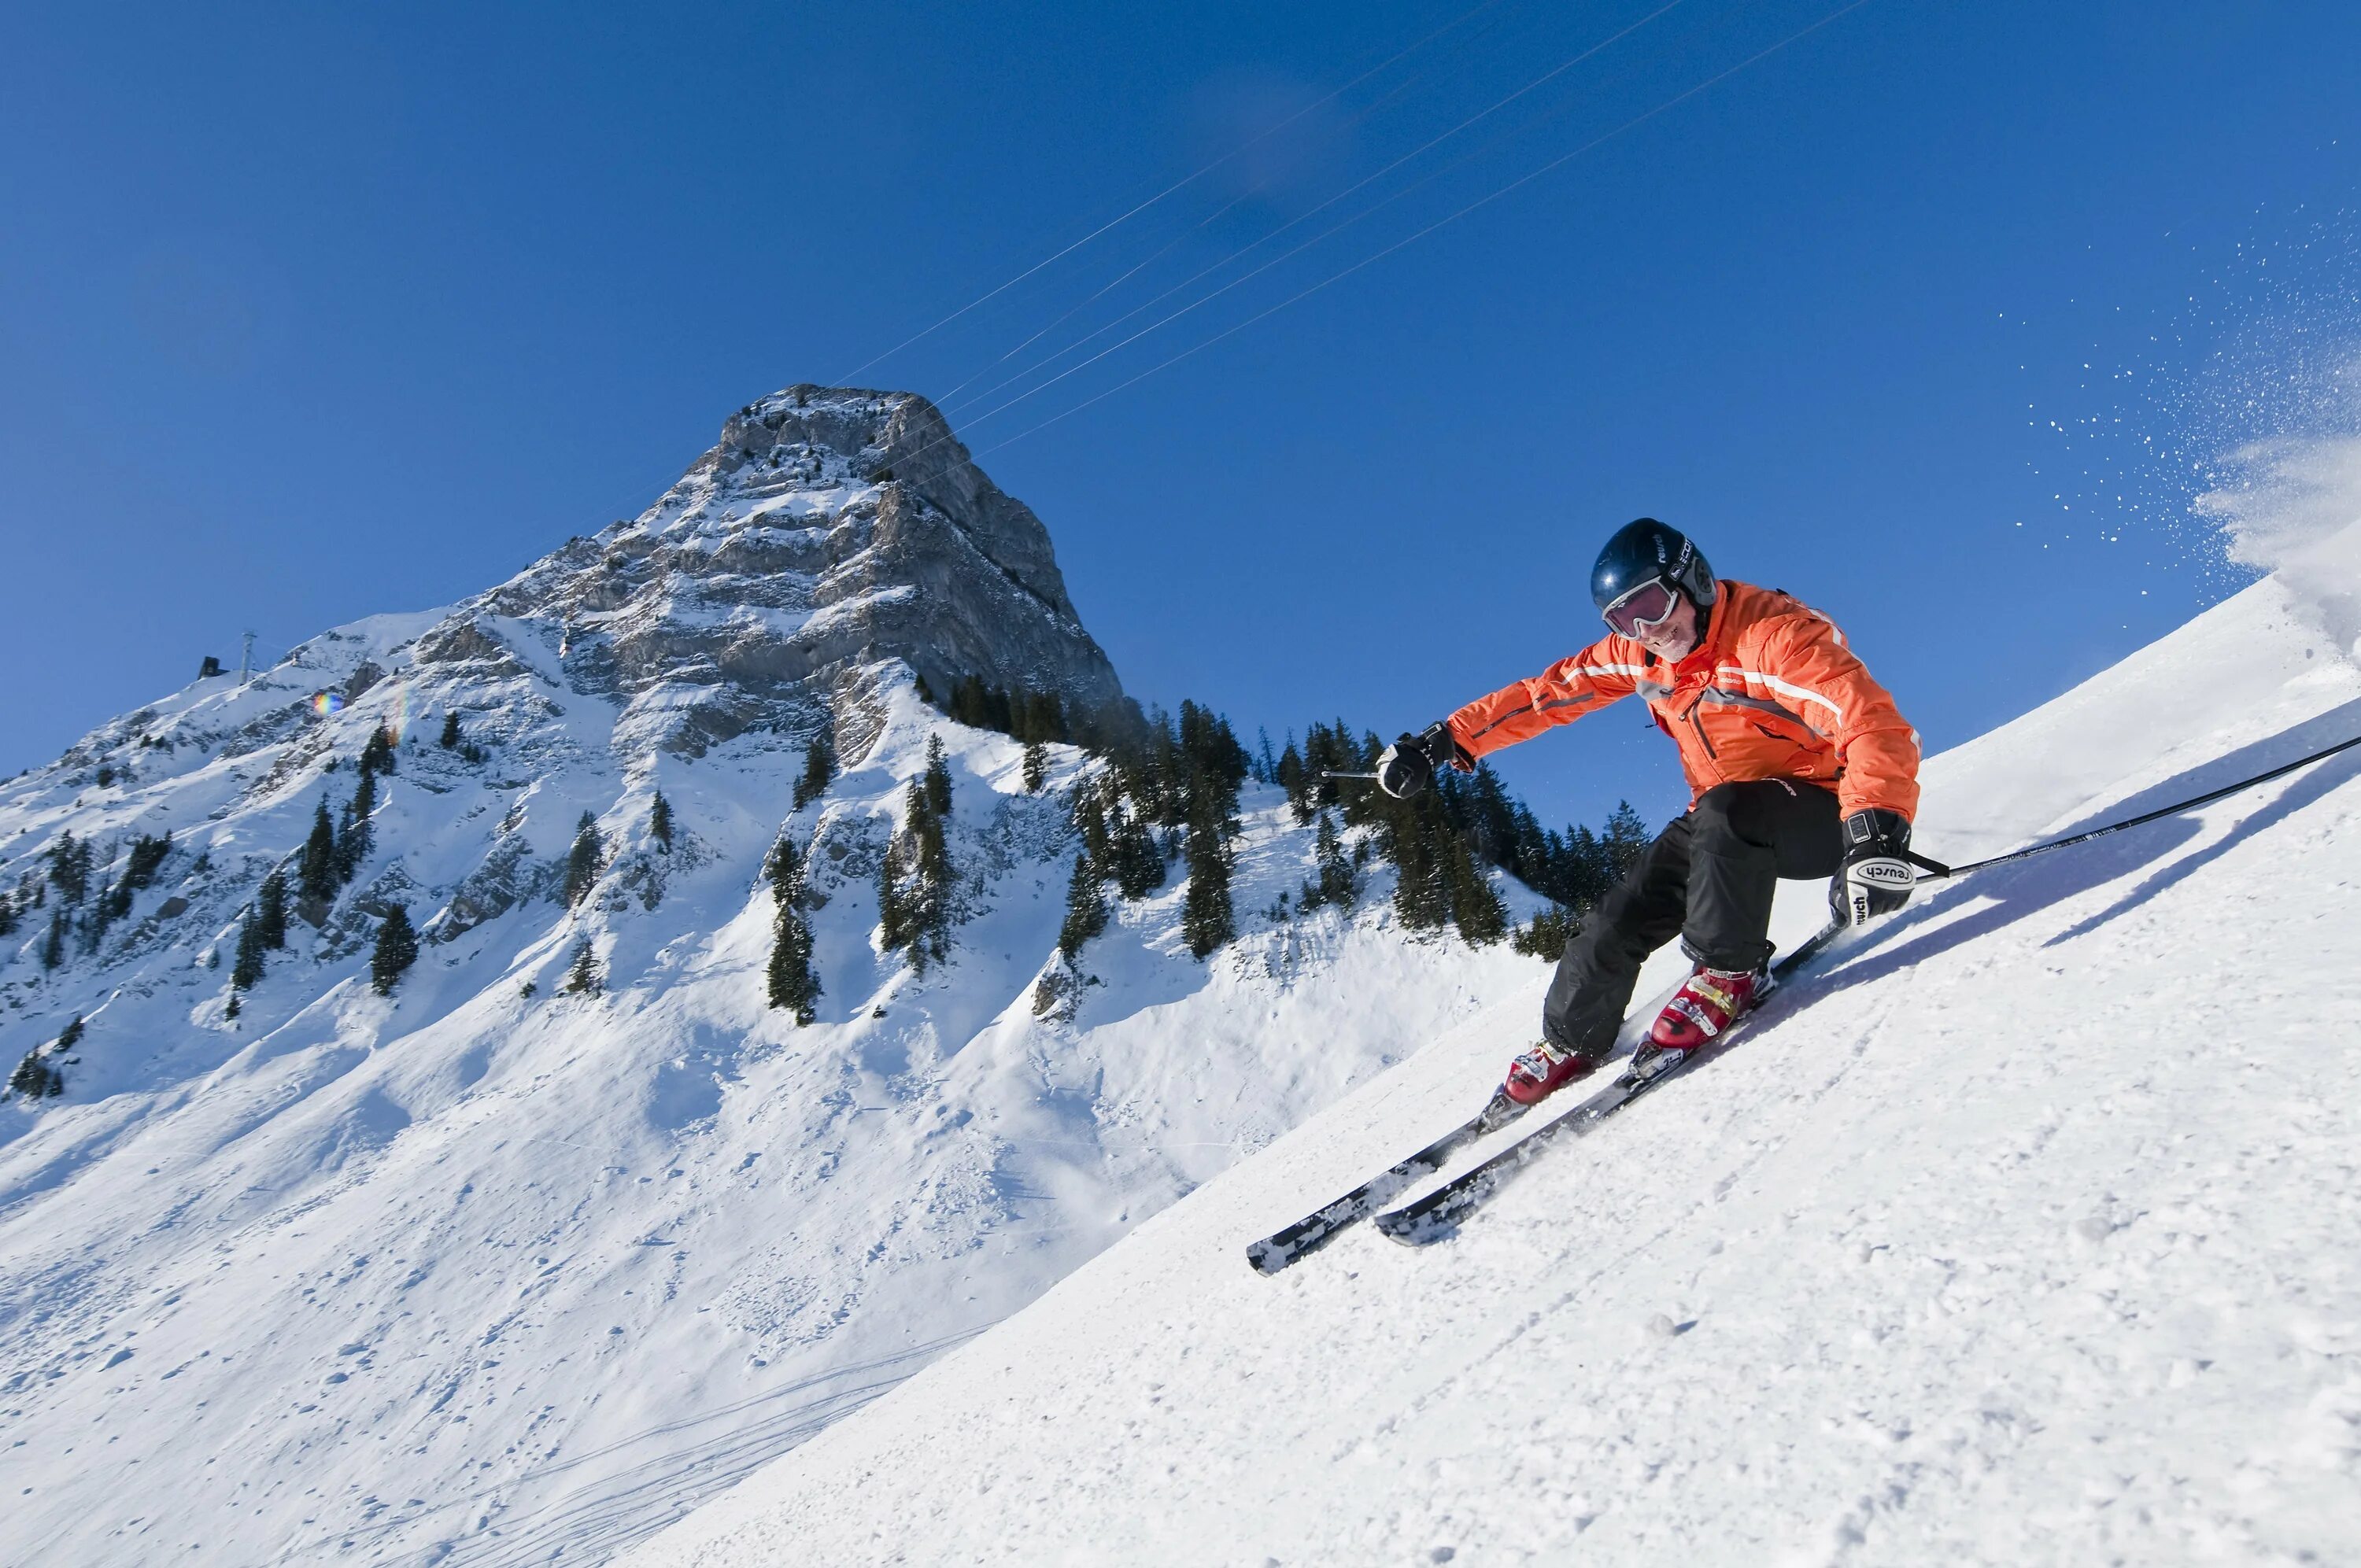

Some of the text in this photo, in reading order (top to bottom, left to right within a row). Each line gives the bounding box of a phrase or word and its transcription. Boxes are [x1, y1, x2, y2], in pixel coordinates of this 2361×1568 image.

[1652, 534, 1666, 563] reusch
[1867, 867, 1909, 880] reusch
[1853, 896, 1866, 925] reusch
